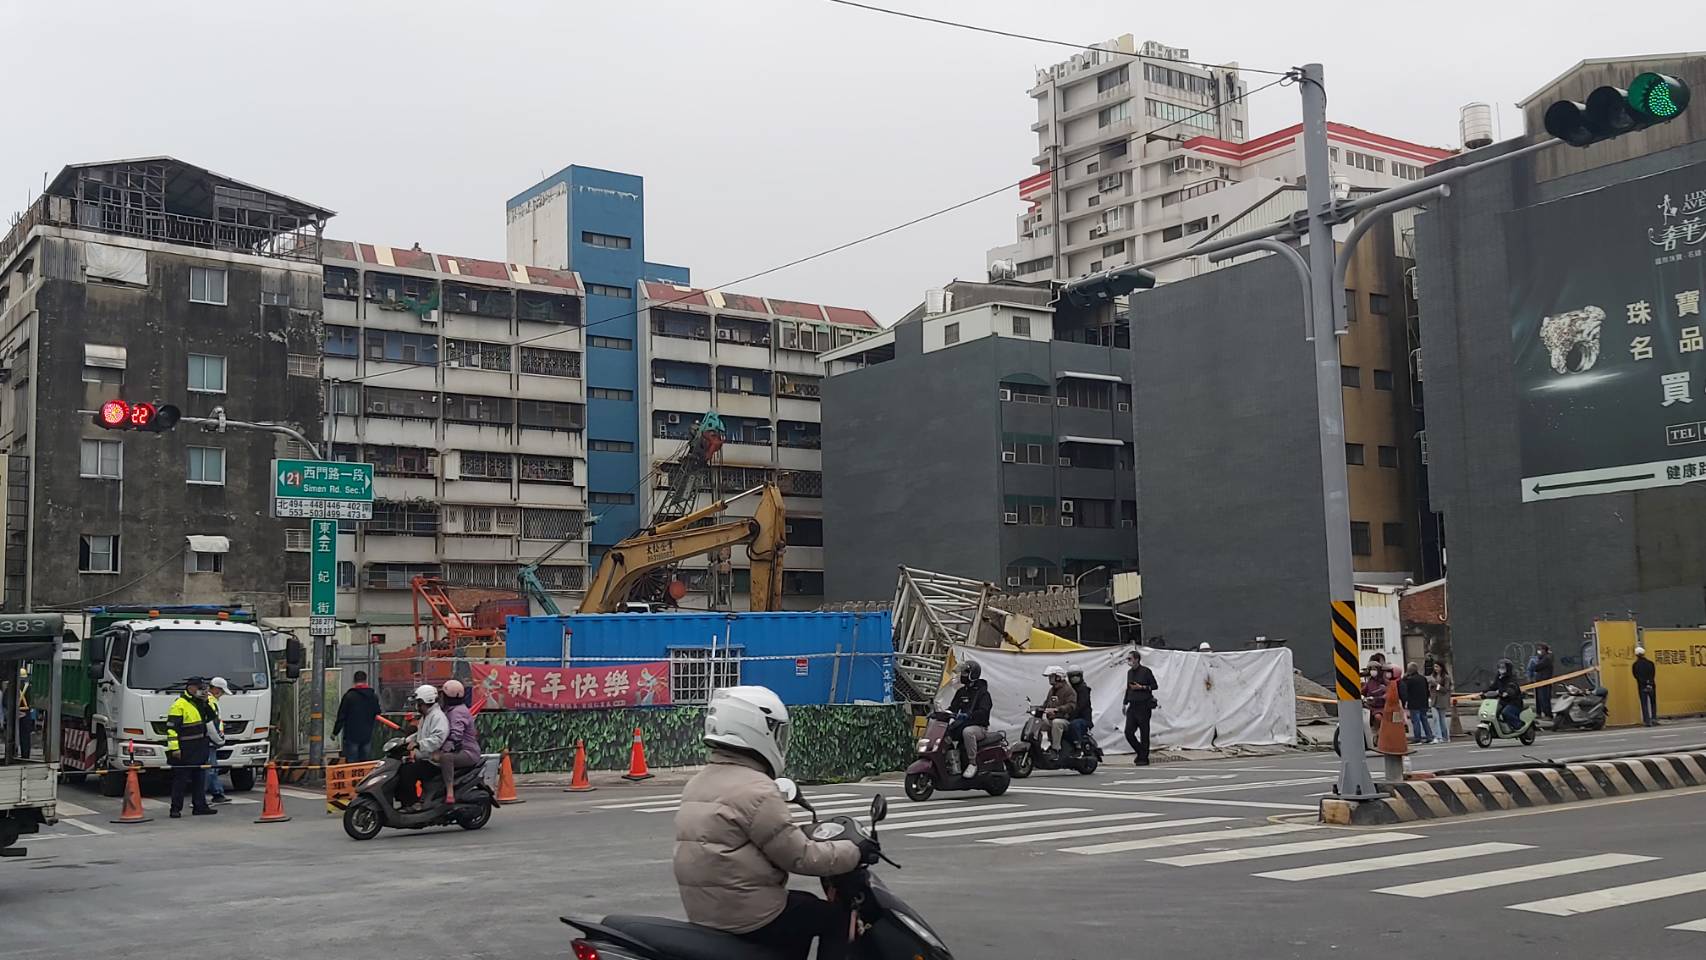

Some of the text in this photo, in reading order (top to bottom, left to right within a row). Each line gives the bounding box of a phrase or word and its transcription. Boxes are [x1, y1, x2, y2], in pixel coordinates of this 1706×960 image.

[1661, 371, 1694, 406] 買
[131, 406, 148, 424] 22
[1670, 428, 1696, 440] TEL
[286, 472, 300, 486] 21
[303, 466, 364, 482] 西門路一段
[303, 484, 326, 493] Simen
[318, 522, 331, 534] 東
[317, 541, 331, 614] 五妃街
[508, 669, 631, 700] 新年快樂
